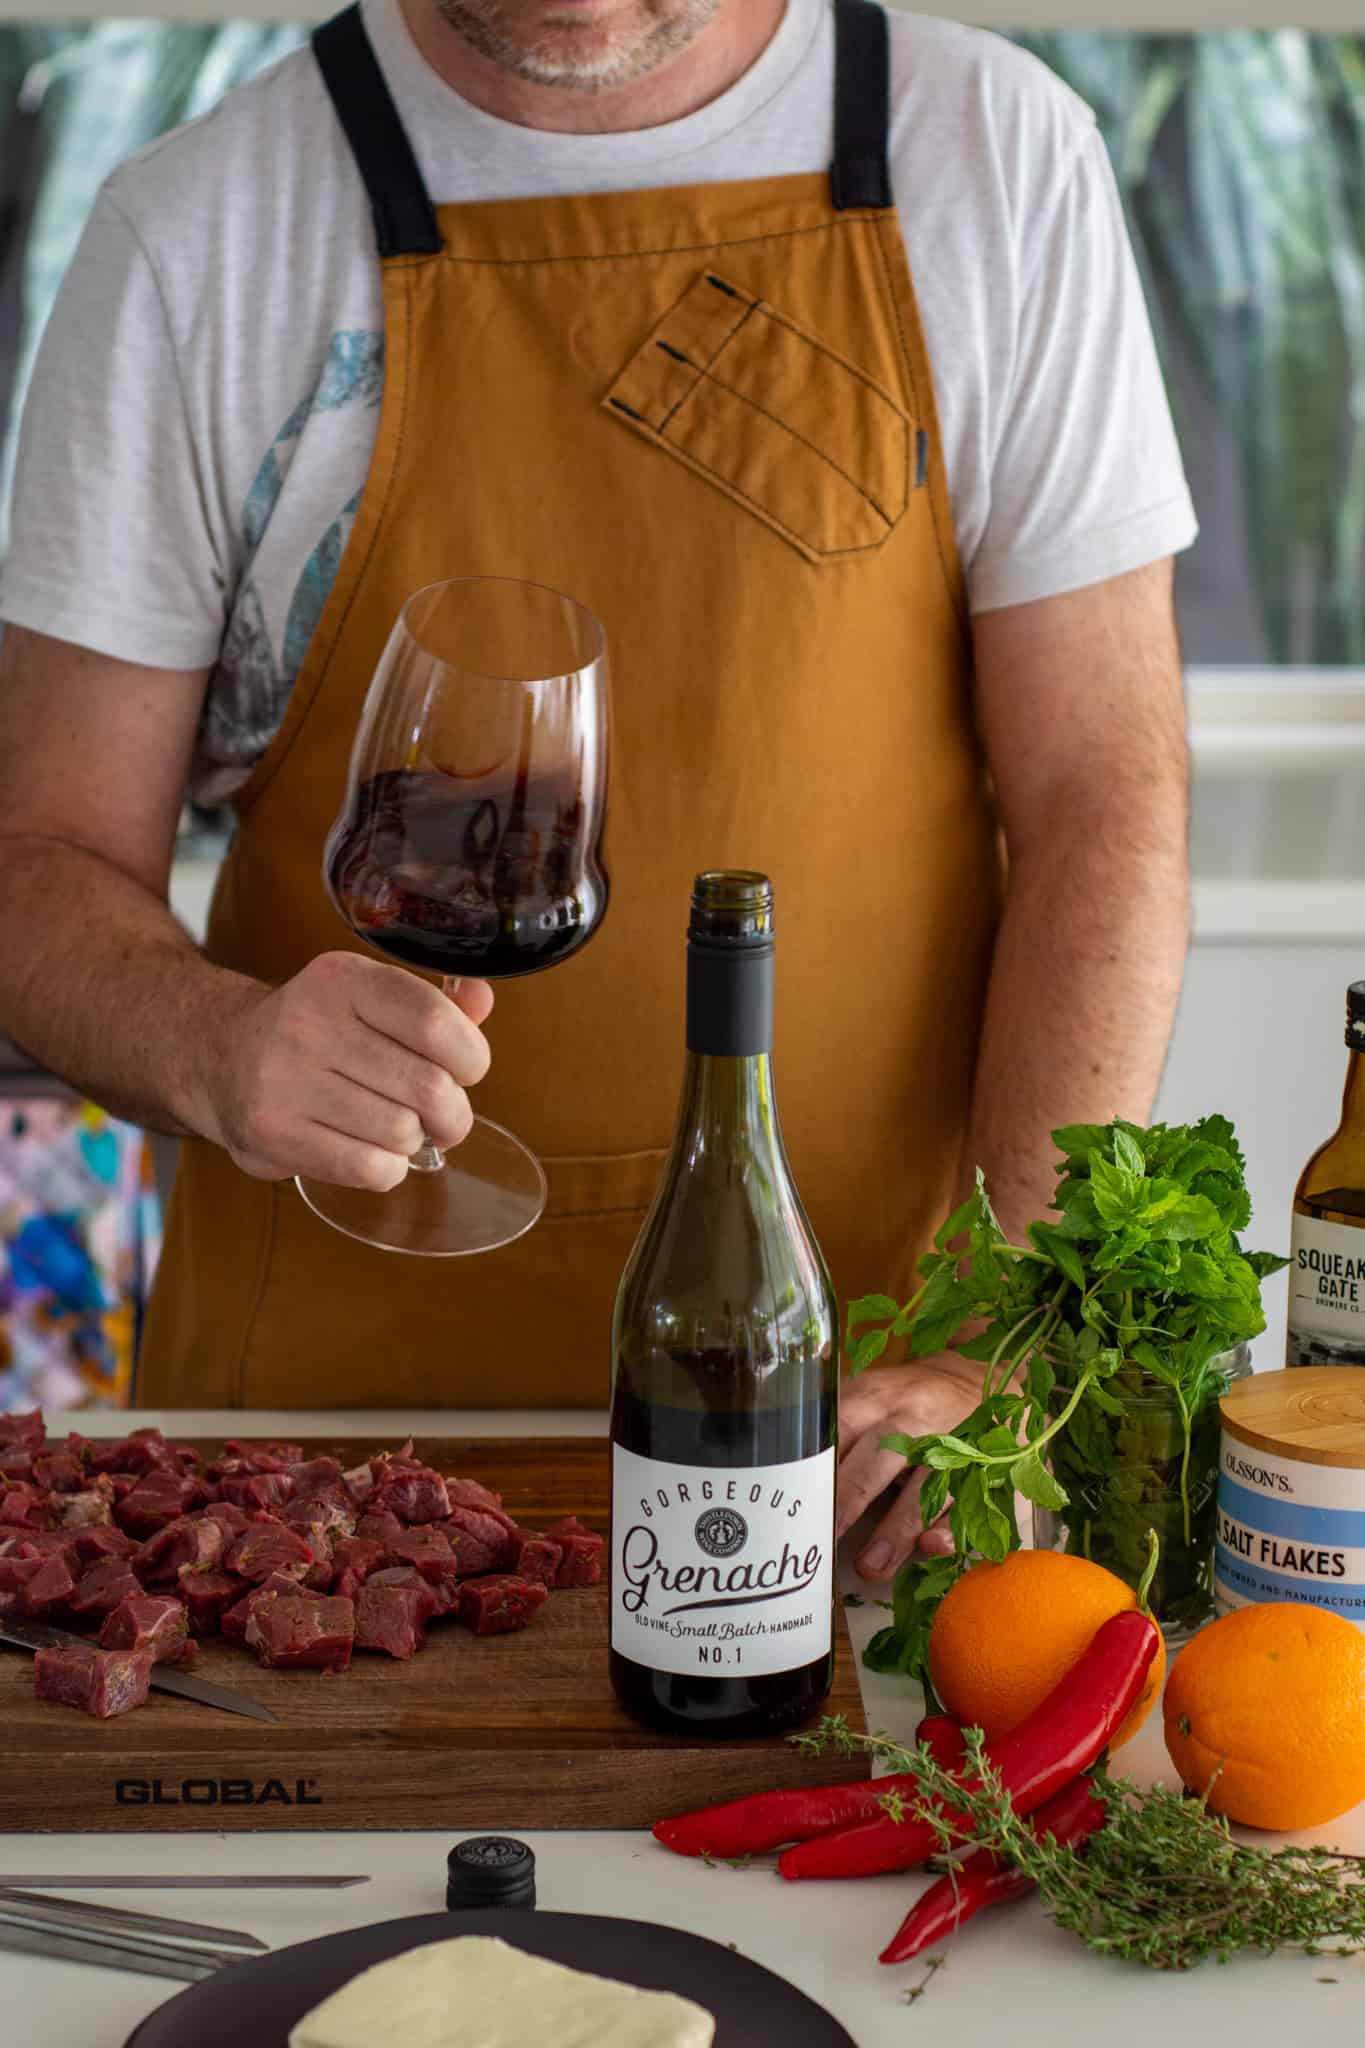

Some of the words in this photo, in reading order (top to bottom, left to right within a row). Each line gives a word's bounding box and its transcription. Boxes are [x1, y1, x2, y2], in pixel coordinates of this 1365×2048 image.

[1318, 1275, 1359, 1302] GATE
[1225, 1452, 1289, 1493] OLSSON'S
[640, 1480, 802, 1518] GORGEOUS
[1223, 1519, 1254, 1556] SALT
[1260, 1538, 1345, 1577] FLAKES
[622, 1525, 823, 1614] Grenache
[1260, 1583, 1281, 1595] AND
[634, 1613, 649, 1626] OLD
[650, 1617, 670, 1633] VINE
[669, 1620, 718, 1638] Small
[718, 1622, 769, 1641] Batch
[769, 1614, 813, 1634] HANDMADE
[115, 1777, 322, 1805] GLOBAL
